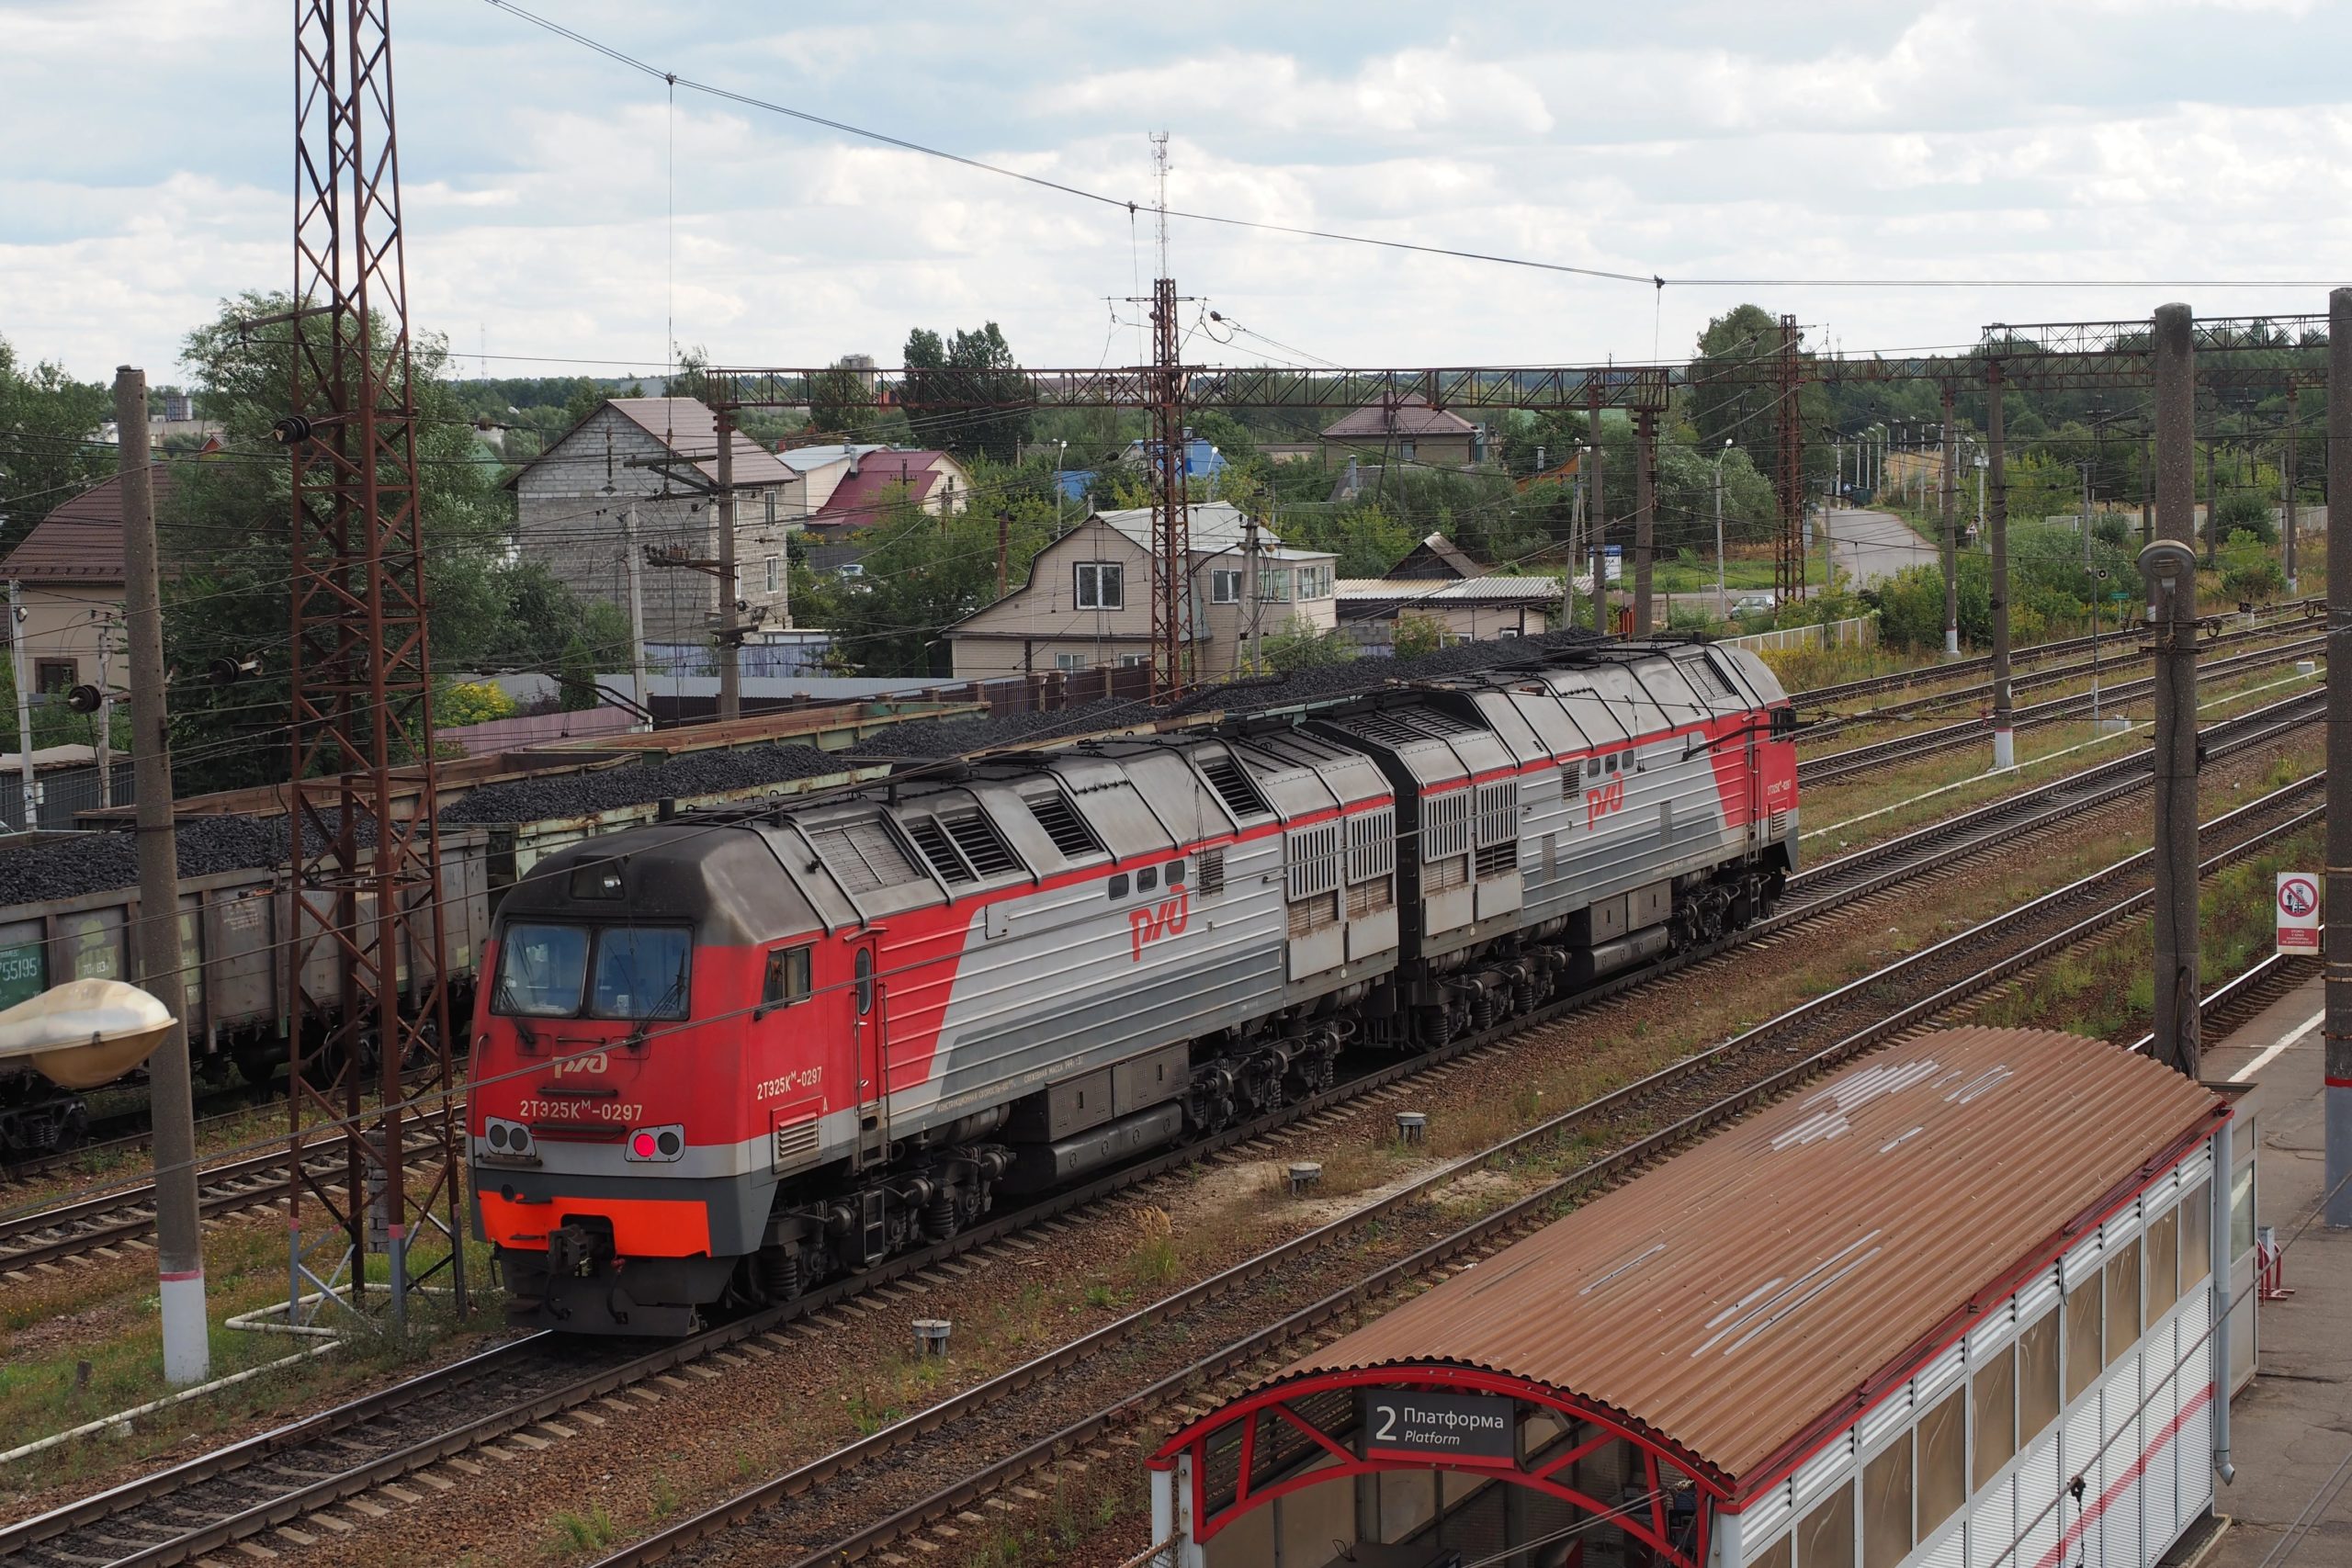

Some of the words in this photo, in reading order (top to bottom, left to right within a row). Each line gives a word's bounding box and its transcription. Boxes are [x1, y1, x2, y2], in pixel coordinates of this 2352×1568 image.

[1587, 772, 1623, 831] РЖД
[1128, 884, 1188, 963] РЖД
[552, 1052, 608, 1078] РЖД
[1375, 1405, 1396, 1441] 2
[1404, 1407, 1504, 1431] Платформа
[1405, 1430, 1460, 1446] Platform
